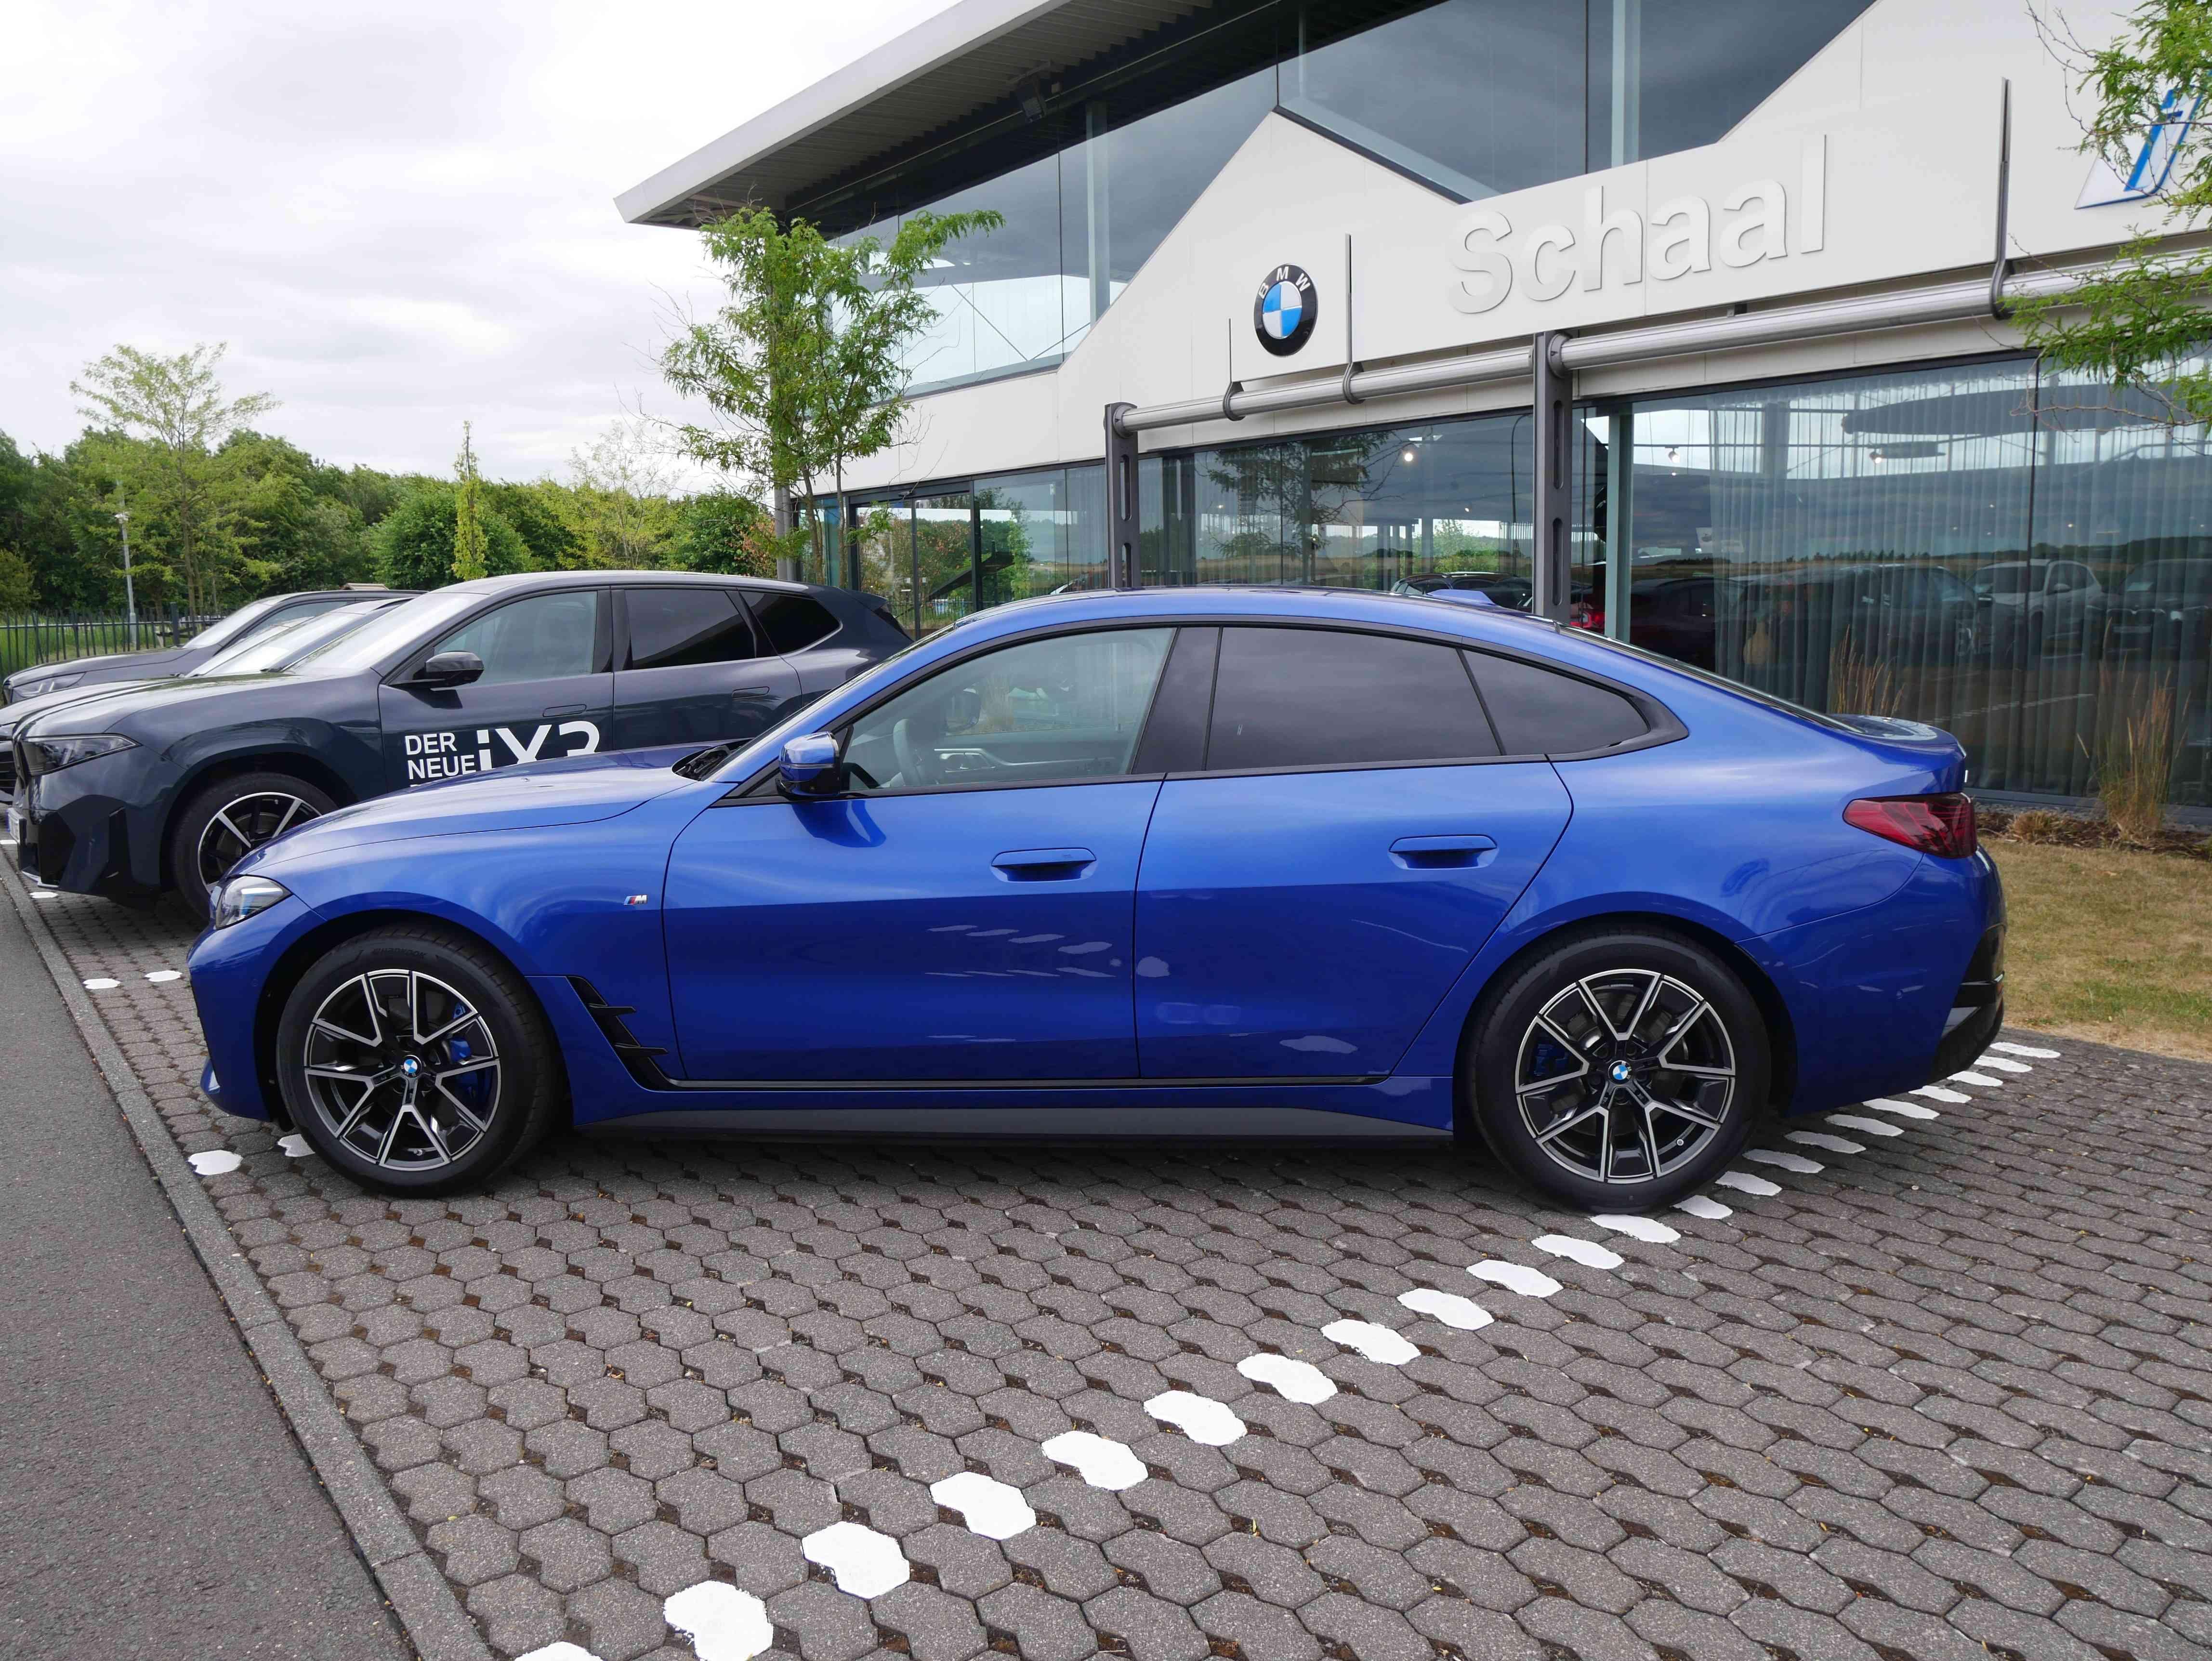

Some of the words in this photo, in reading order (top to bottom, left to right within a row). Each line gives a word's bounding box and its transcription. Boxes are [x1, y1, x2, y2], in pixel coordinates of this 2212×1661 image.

[1448, 134, 1826, 314] Schaal
[1258, 266, 1311, 300] BMW
[405, 732, 457, 755] DER
[408, 754, 476, 779] NEUE
